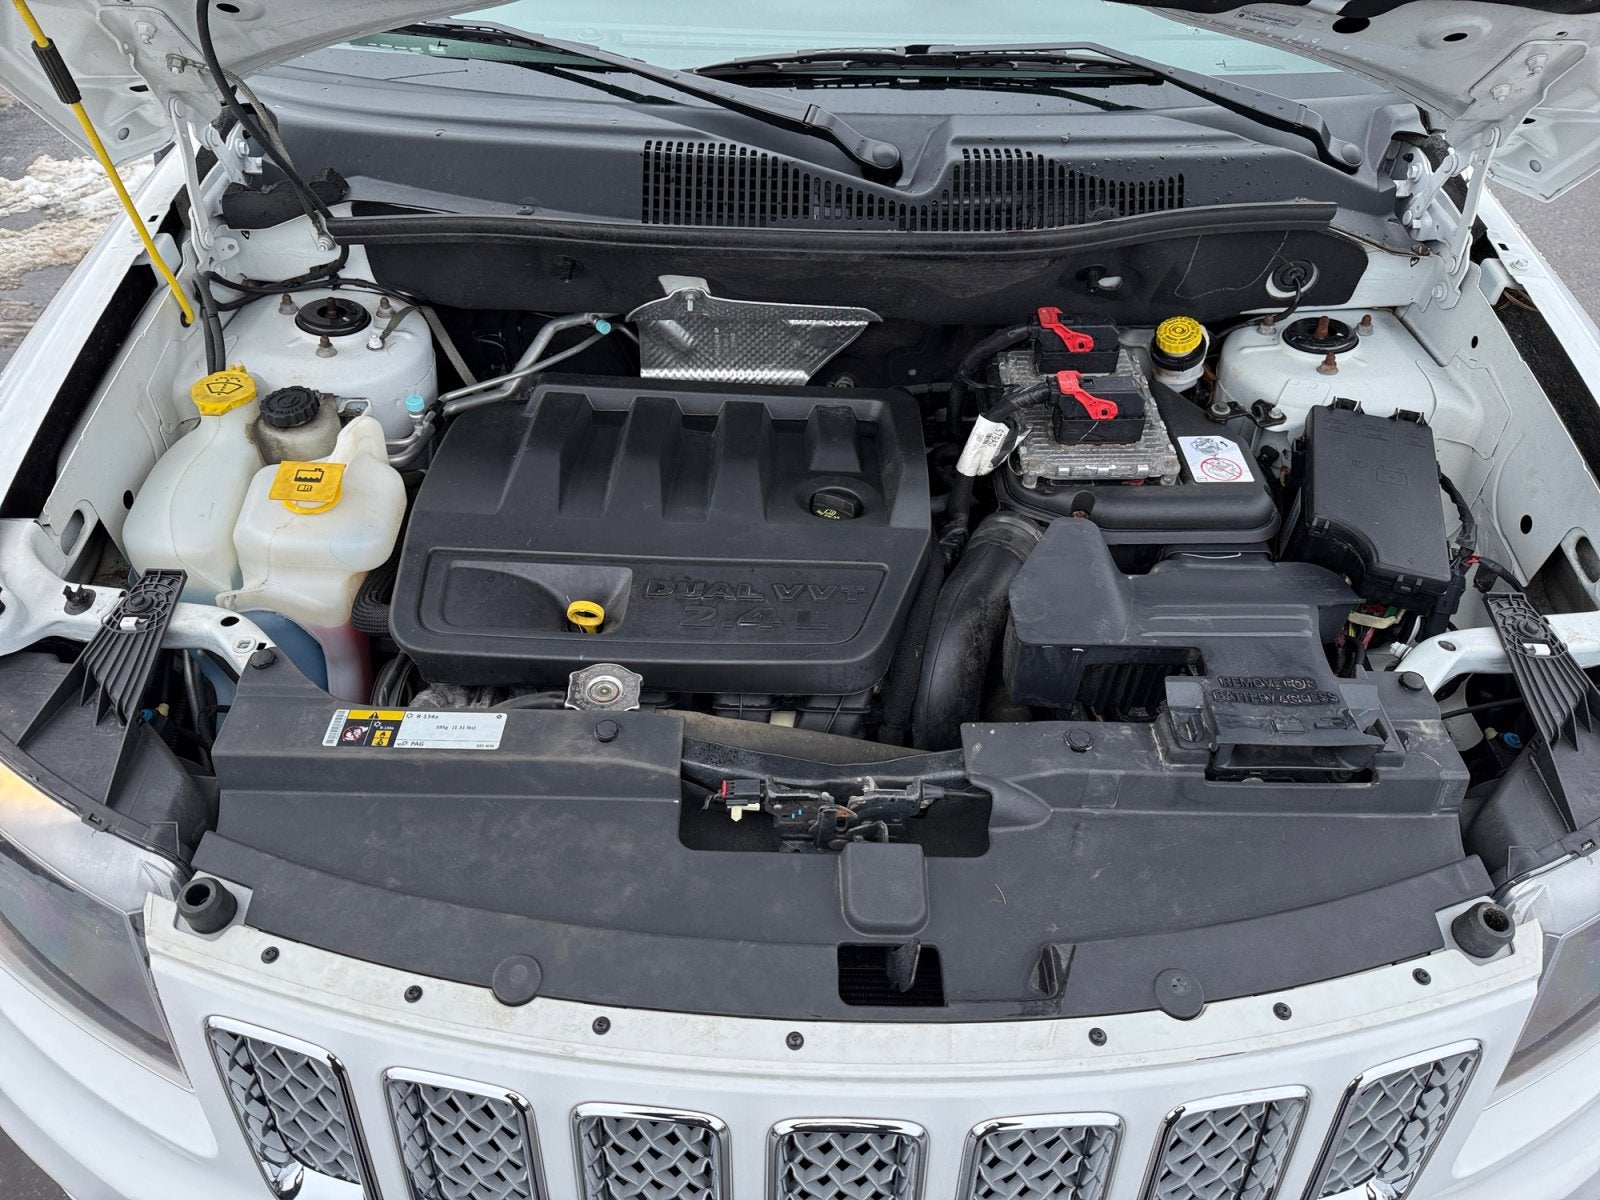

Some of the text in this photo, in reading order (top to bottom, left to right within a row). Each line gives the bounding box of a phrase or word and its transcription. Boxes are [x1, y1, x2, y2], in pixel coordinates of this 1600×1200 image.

[645, 579, 865, 602] DUAL VVT
[1218, 676, 1316, 690] REMOVE FOR
[1212, 690, 1338, 705] BATTERY ACCESS
